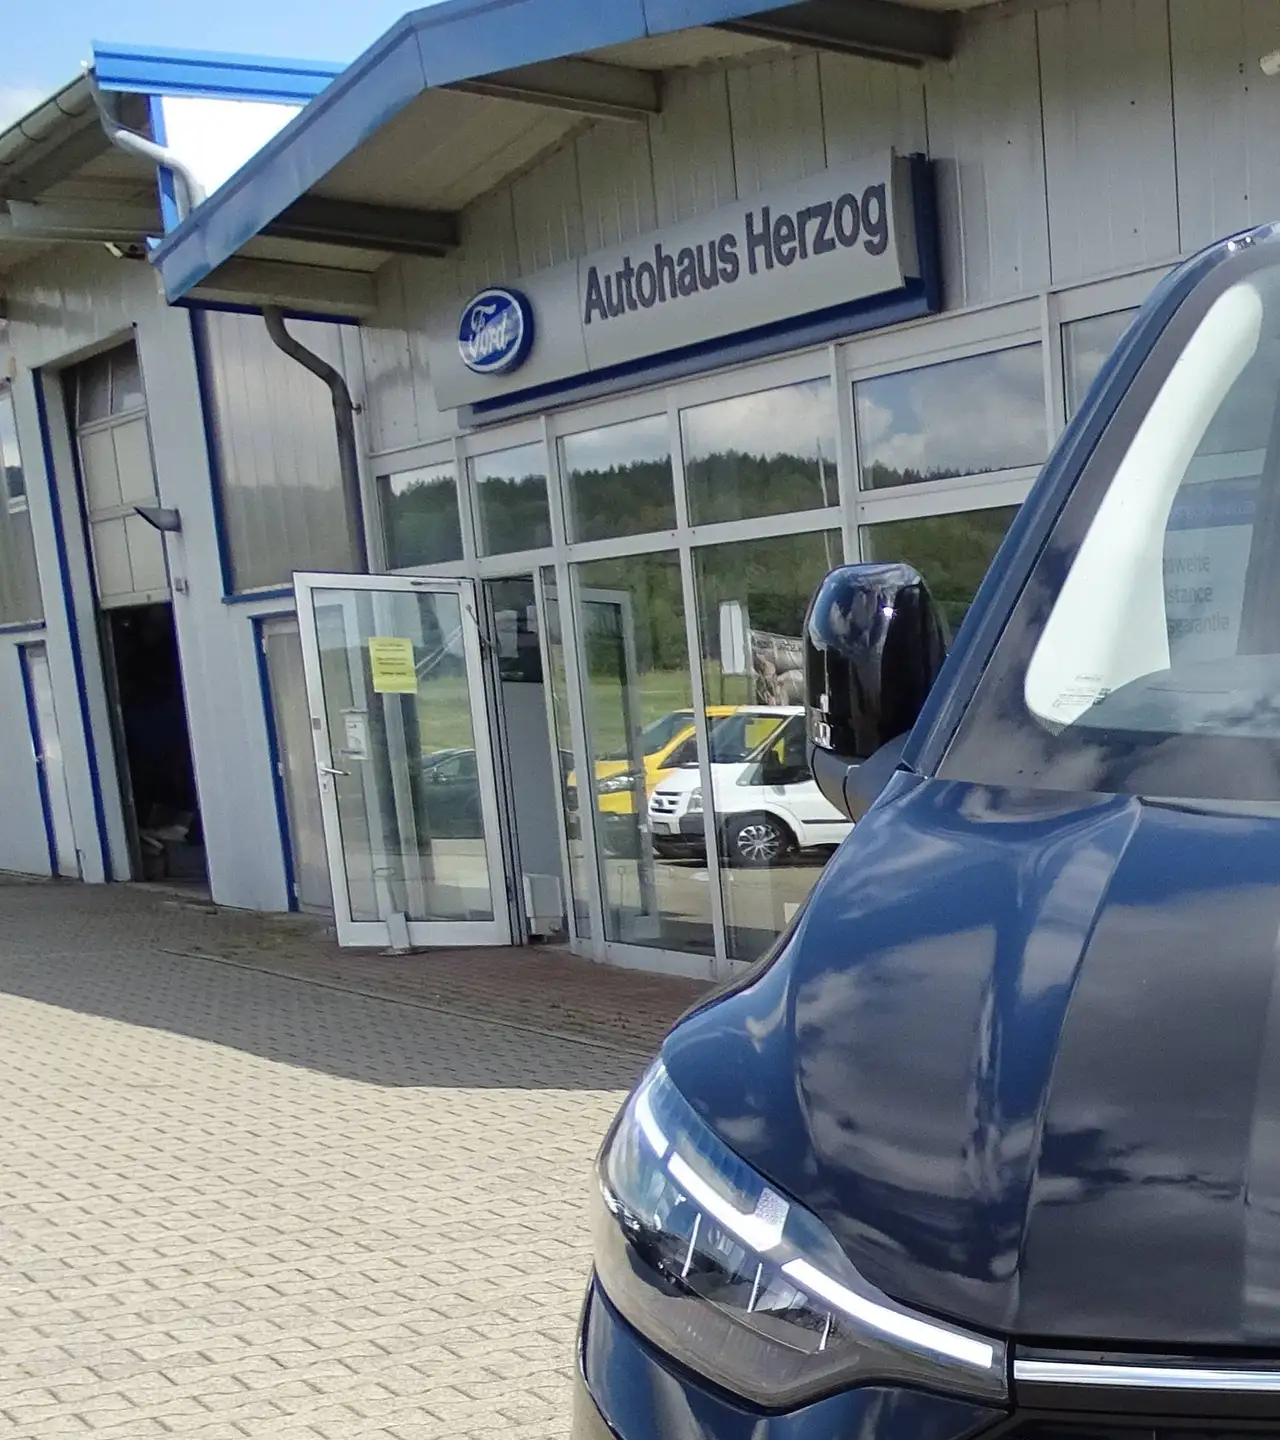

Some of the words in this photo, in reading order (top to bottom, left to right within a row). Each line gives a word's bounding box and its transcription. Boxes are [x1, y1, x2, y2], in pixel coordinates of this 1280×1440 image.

[584, 231, 740, 325] Autohaus
[745, 183, 887, 275] Herzog
[469, 304, 508, 359] Ford
